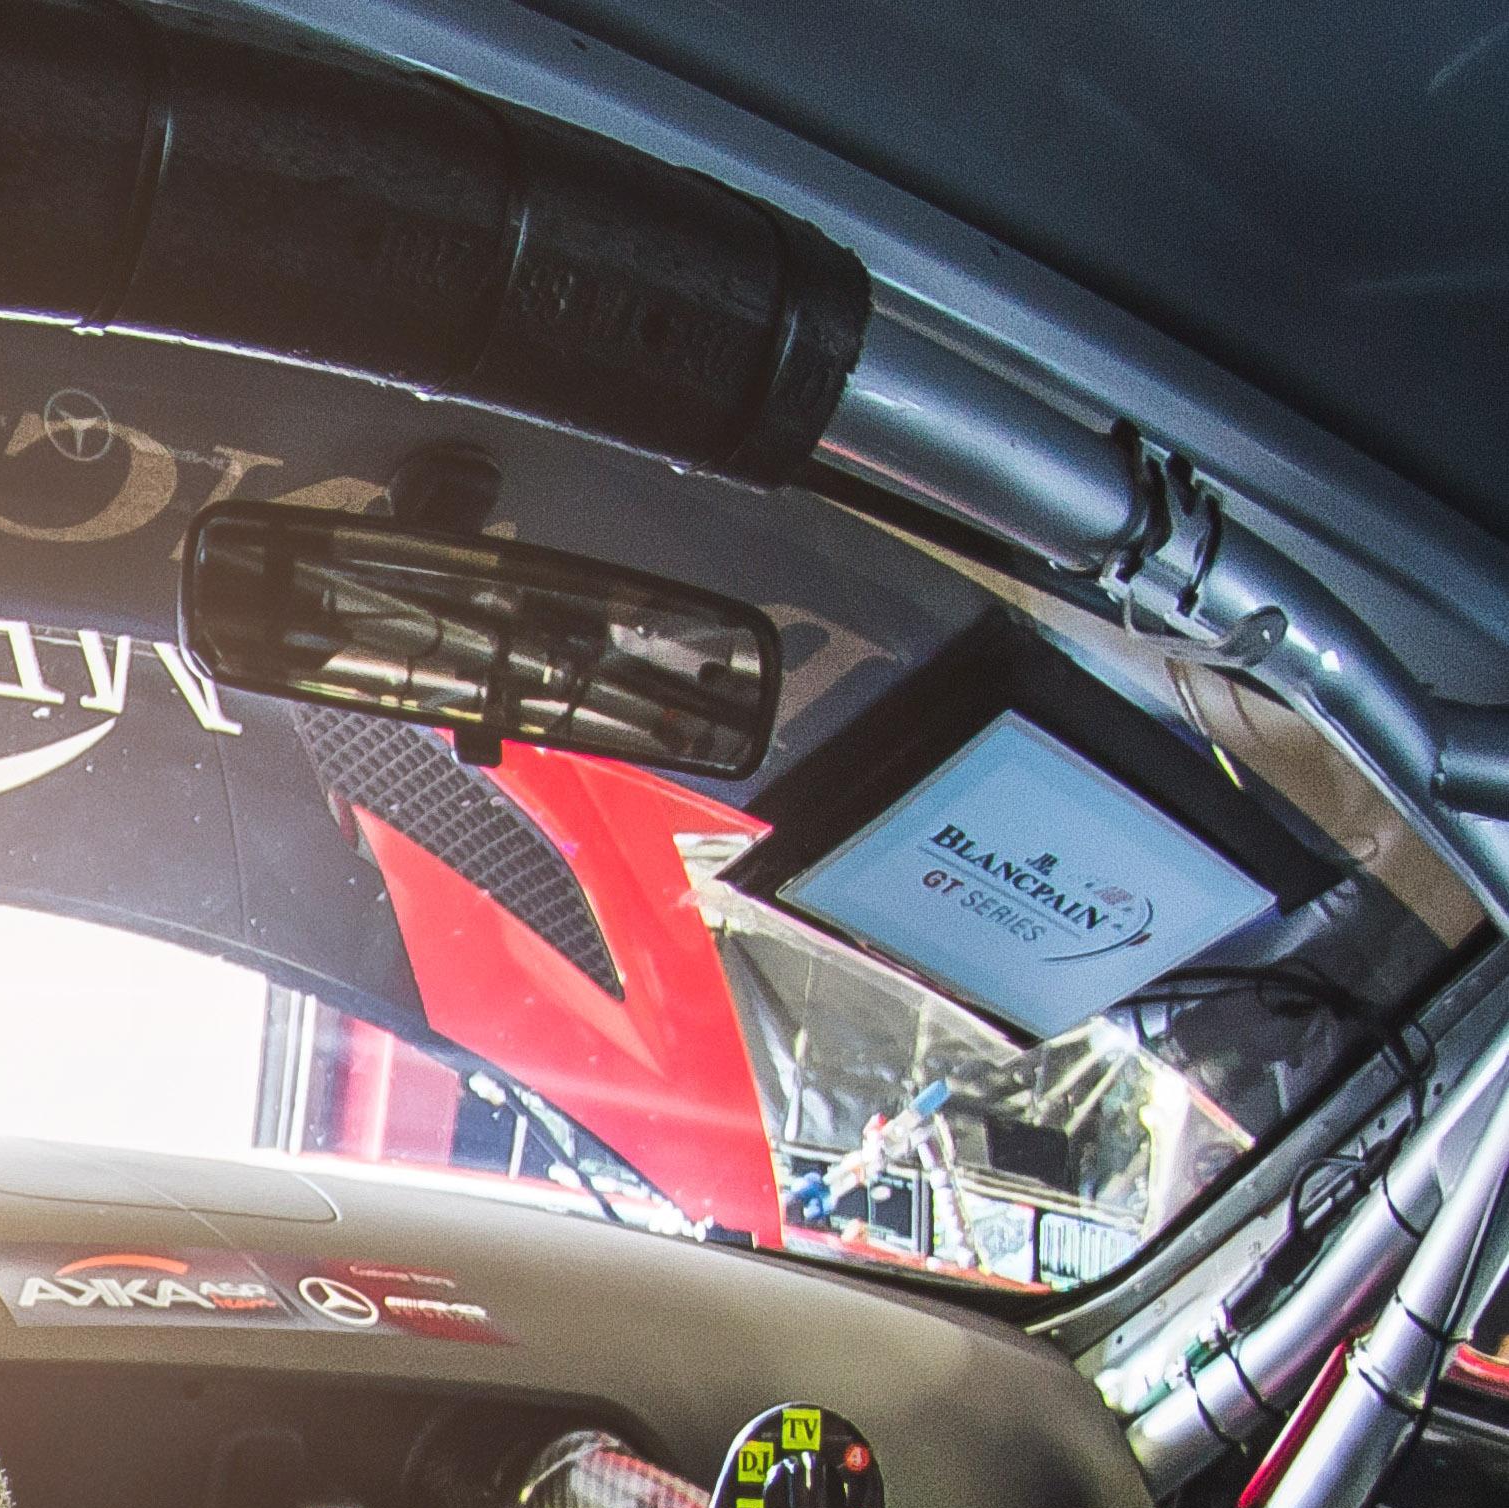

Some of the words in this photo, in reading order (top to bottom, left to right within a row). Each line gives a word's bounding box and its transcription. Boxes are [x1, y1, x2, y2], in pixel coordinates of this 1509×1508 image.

[929, 824, 1112, 930] BLANCPAIN
[923, 869, 964, 896] GT
[960, 889, 1046, 943] SERIES
[19, 1278, 216, 1310] AKKA
[785, 1417, 820, 1441] TV
[851, 1450, 864, 1466] 4
